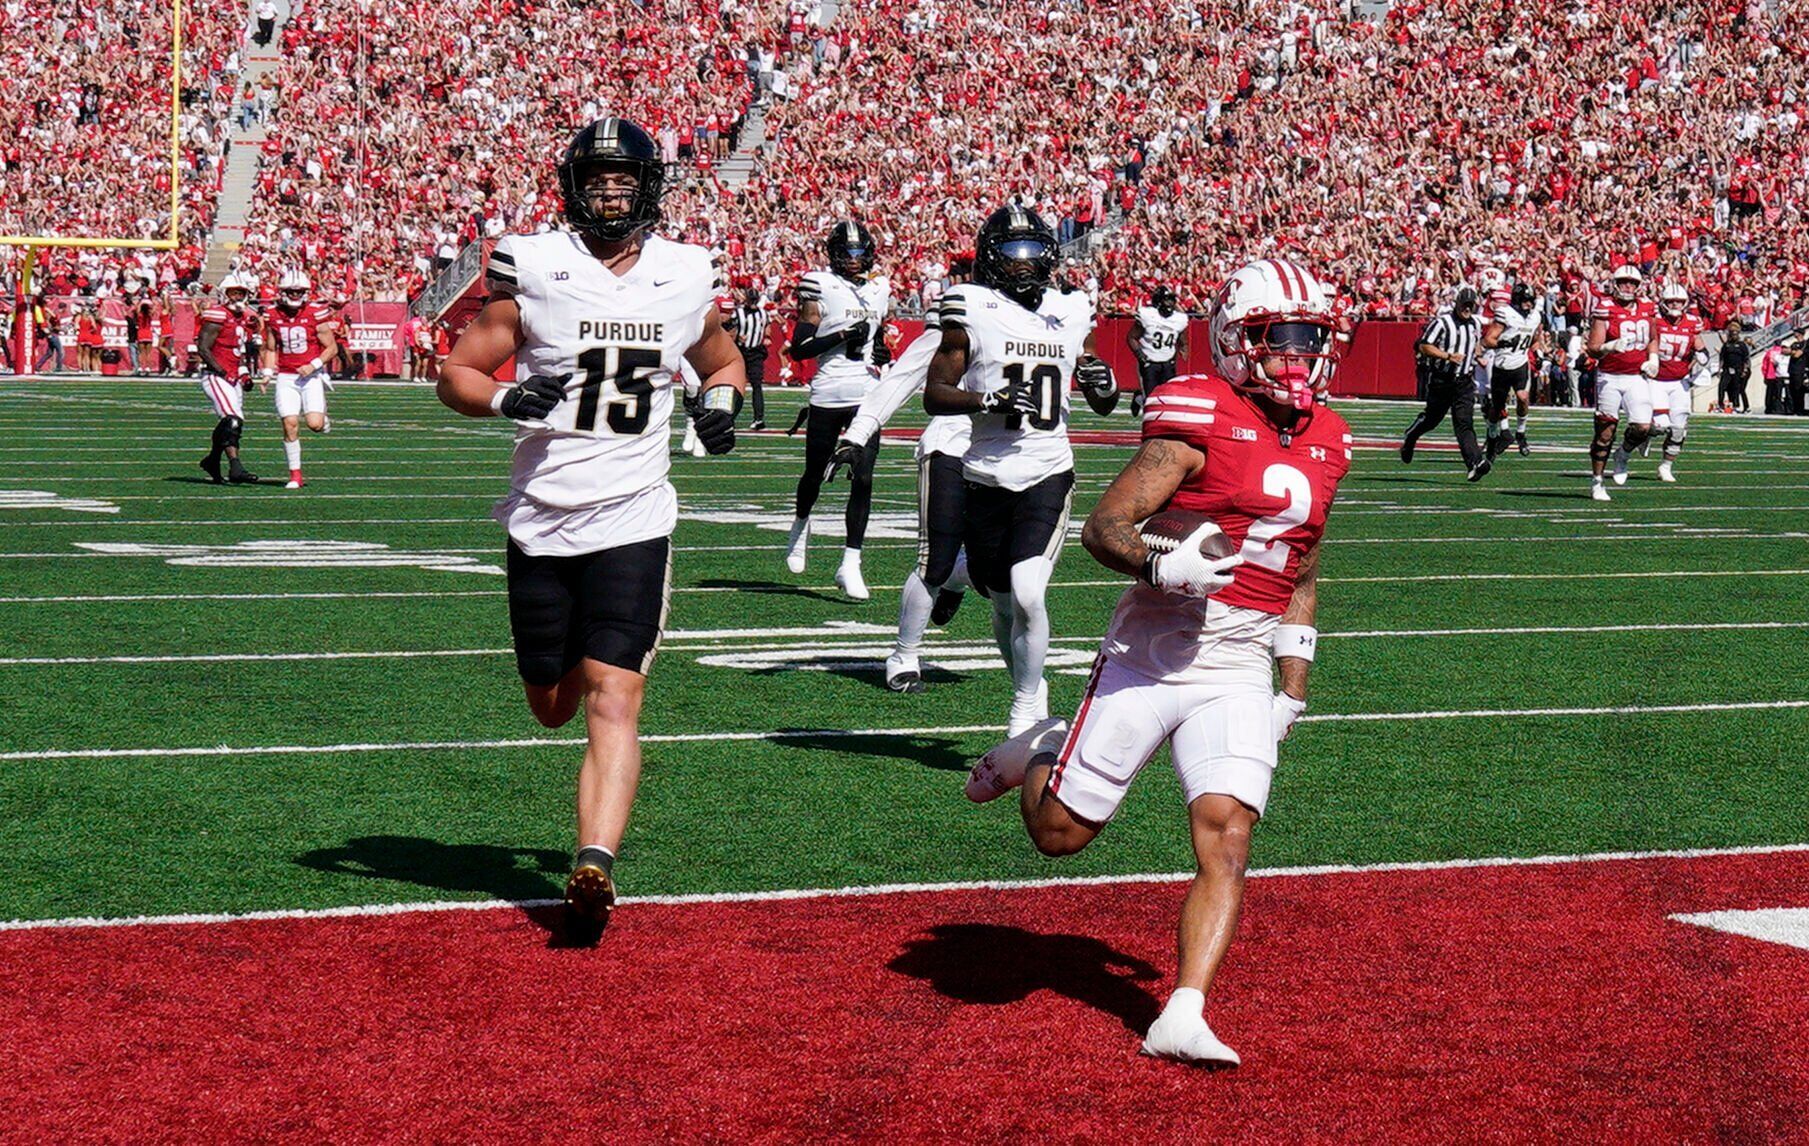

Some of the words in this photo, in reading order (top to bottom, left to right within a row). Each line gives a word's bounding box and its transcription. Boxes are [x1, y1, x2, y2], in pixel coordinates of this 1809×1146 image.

[354, 330, 394, 340] FAMILY
[578, 320, 664, 342] PURDUE
[1152, 331, 1175, 350] 34
[1005, 341, 1065, 359] PURDUE
[1659, 333, 1690, 361] 57
[573, 347, 663, 436] 15
[1002, 362, 1062, 431] 10
[1239, 462, 1313, 574] 2
